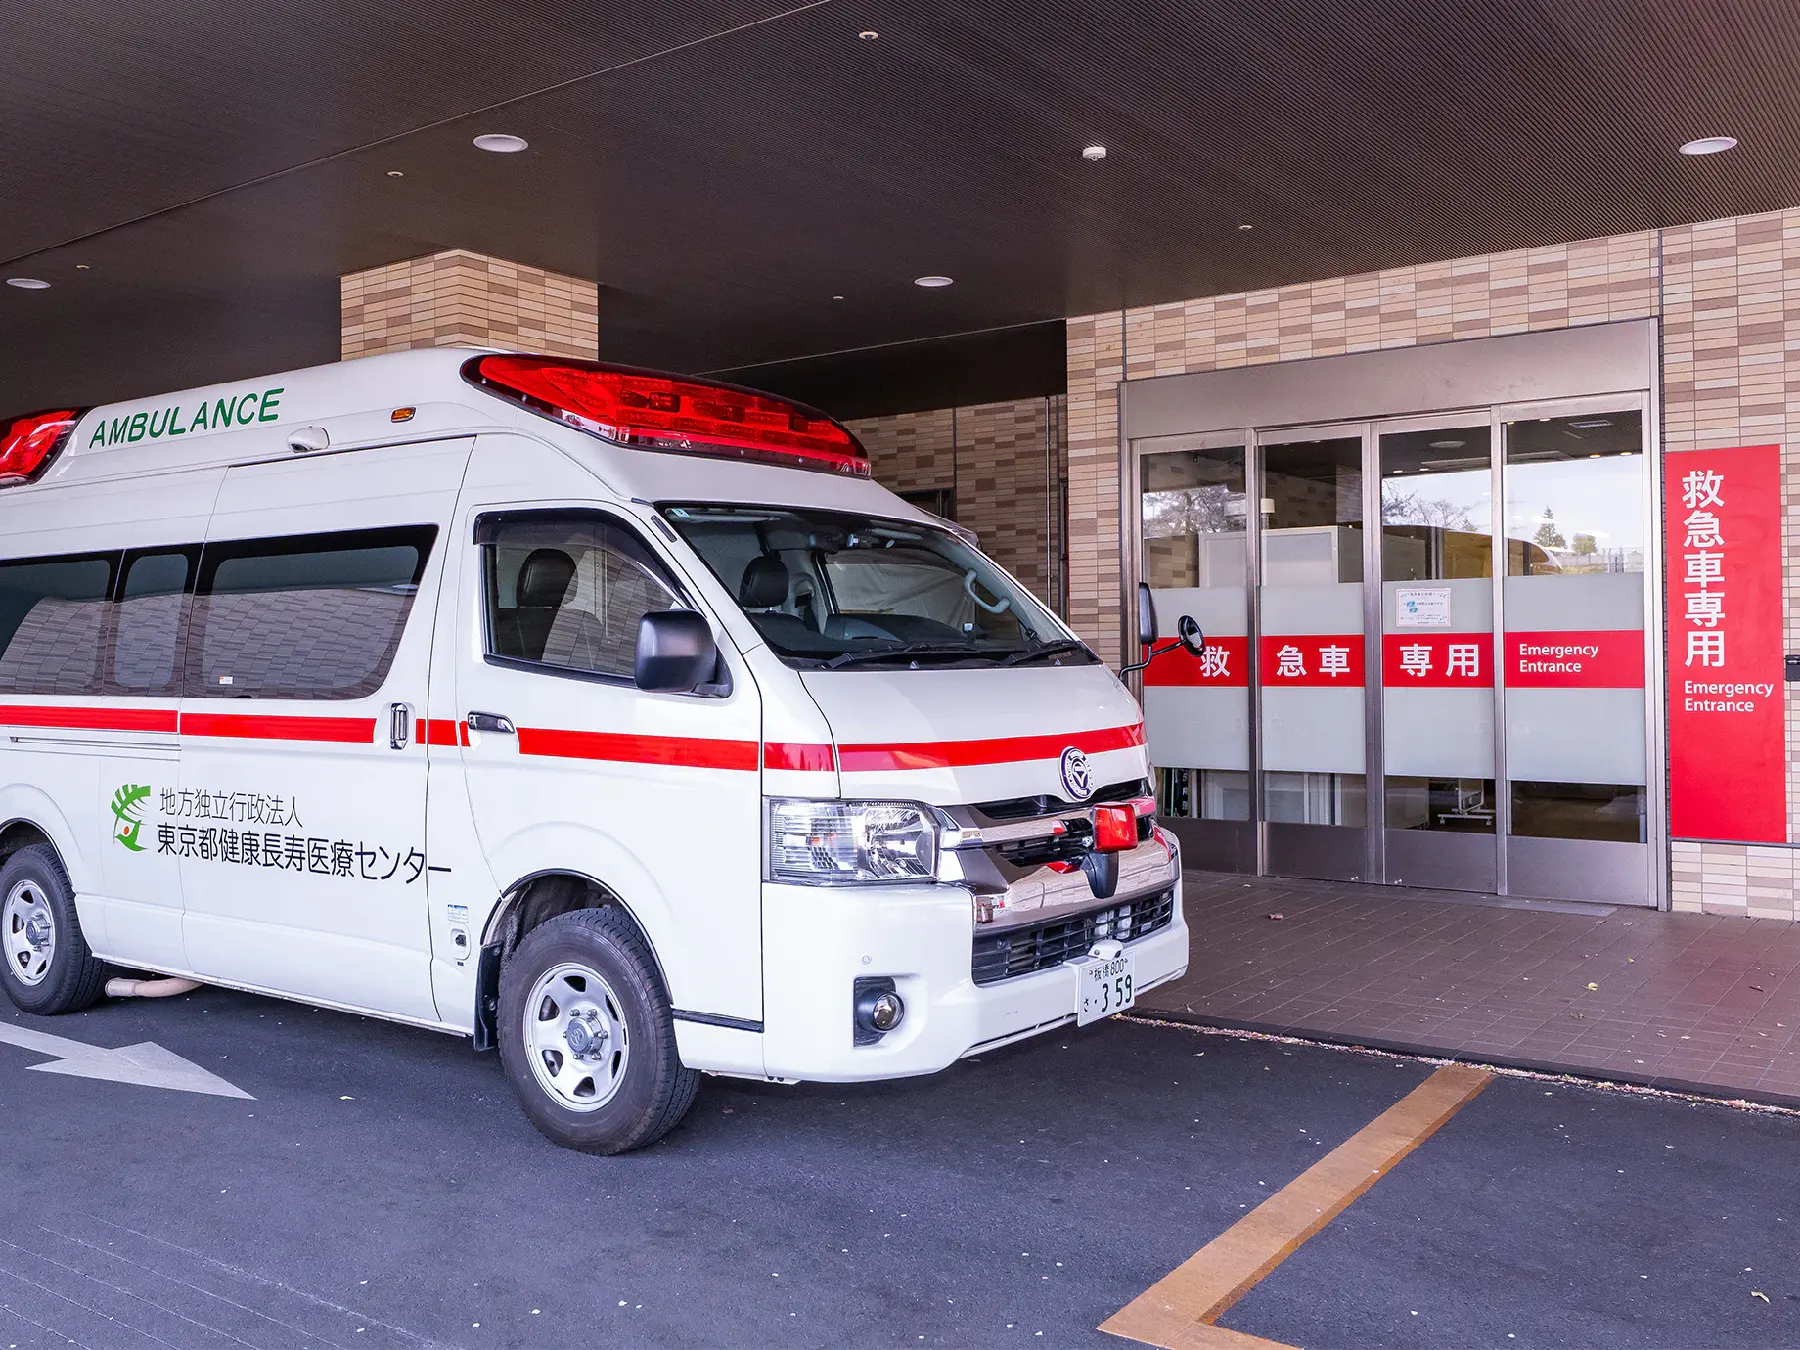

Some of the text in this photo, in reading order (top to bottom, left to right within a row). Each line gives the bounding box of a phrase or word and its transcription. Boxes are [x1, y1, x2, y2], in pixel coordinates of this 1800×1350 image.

[88, 387, 285, 449] AMBULANCE
[1681, 469, 1726, 668] 救急車専用
[1518, 643, 1600, 659] Emergency
[1518, 659, 1583, 673] Entrance
[1684, 680, 1775, 698] Emergency
[1684, 698, 1755, 713] Entrance
[159, 786, 304, 828] 地方独立行政法人
[157, 822, 452, 884] 東京都健康長寿医療センター
